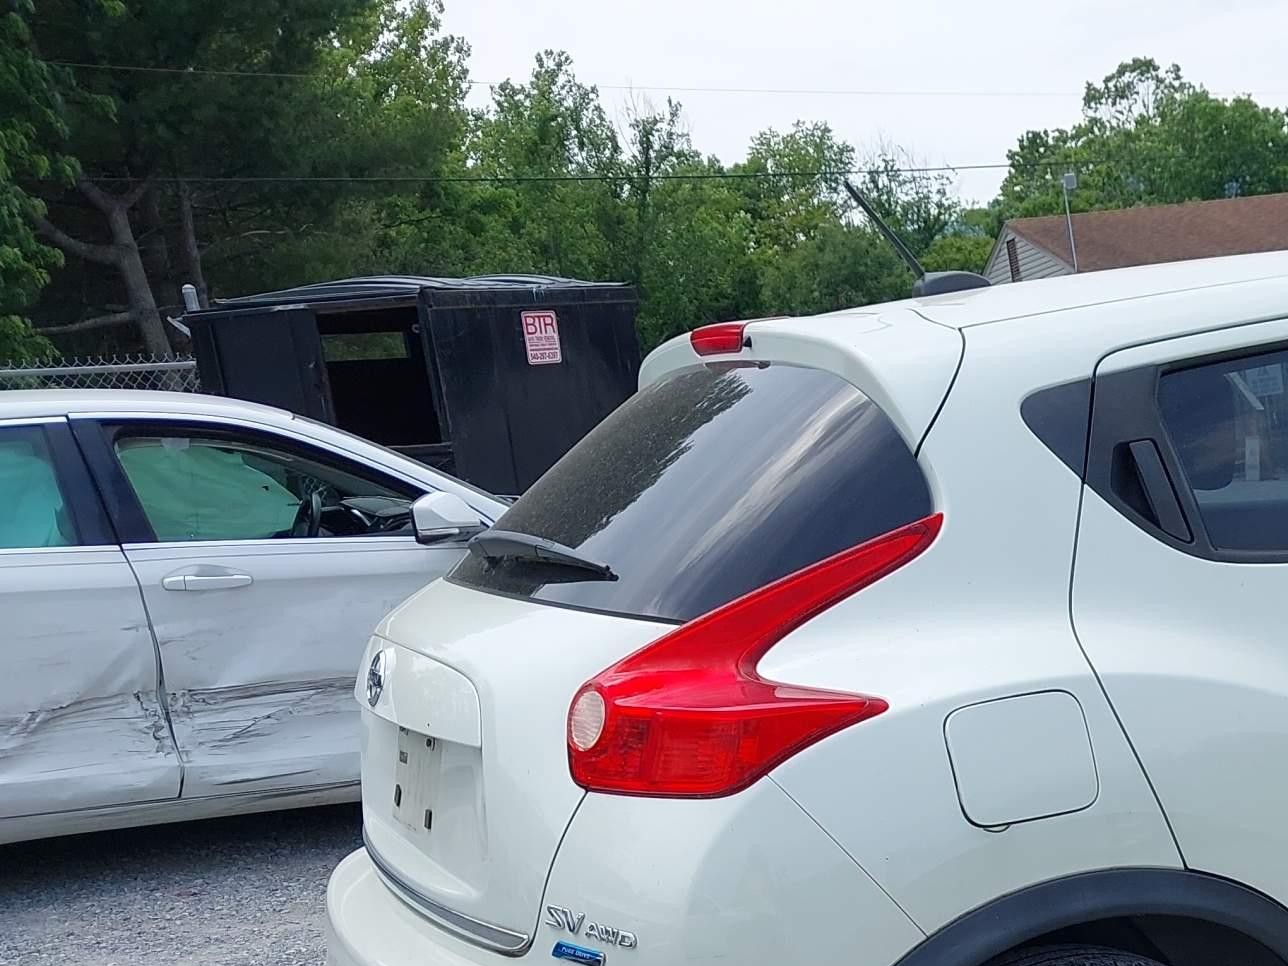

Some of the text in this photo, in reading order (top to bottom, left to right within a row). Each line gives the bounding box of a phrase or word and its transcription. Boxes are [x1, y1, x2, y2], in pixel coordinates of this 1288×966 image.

[524, 314, 556, 335] BTR
[545, 904, 638, 949] SV AWD
